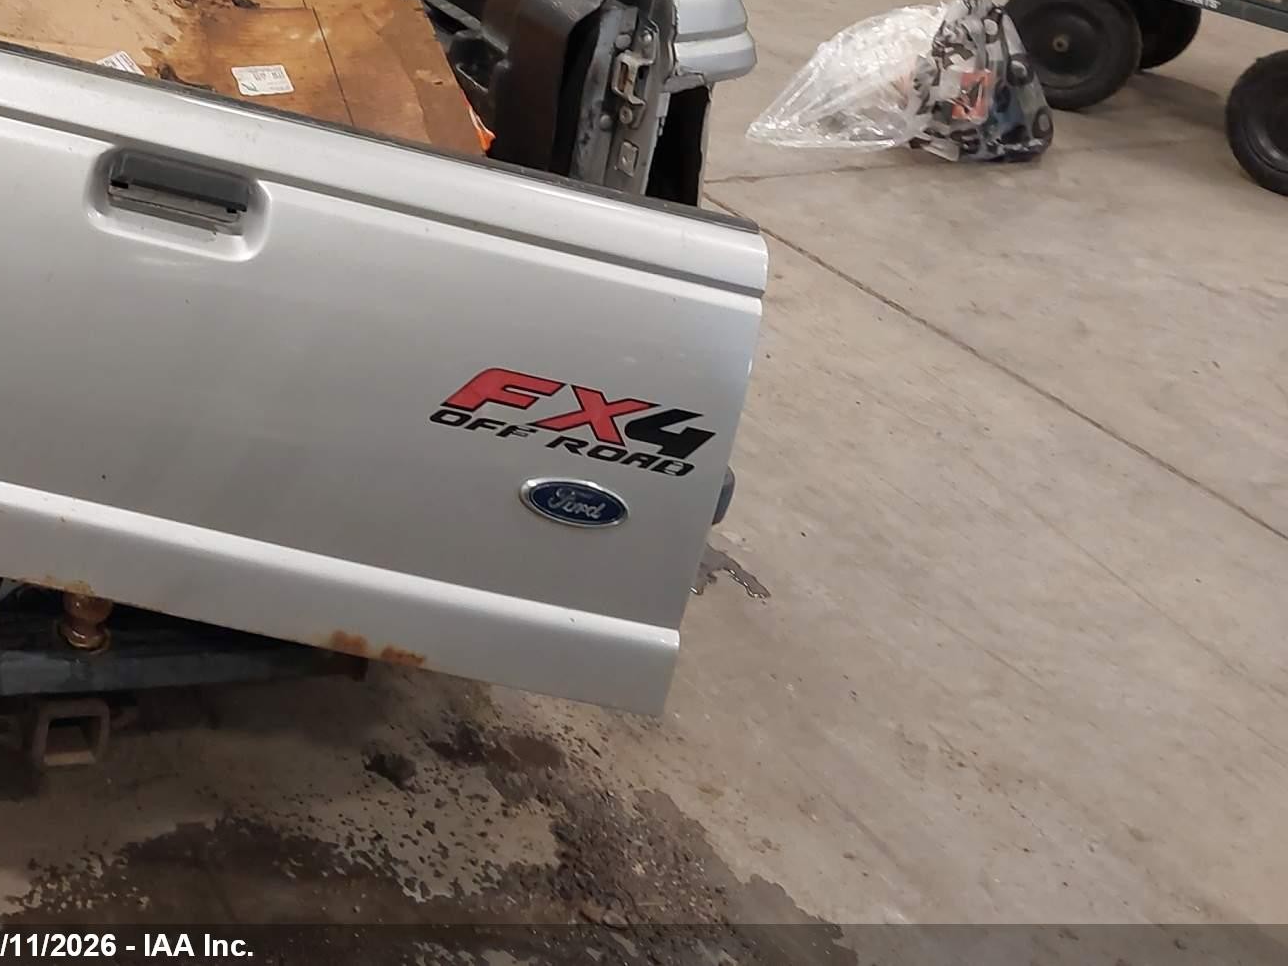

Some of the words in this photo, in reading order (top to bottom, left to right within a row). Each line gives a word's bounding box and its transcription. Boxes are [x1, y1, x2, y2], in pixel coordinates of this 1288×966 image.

[429, 409, 538, 438] OFF
[545, 436, 695, 477] ROAD
[440, 367, 716, 459] FX4
[547, 488, 607, 519] Ford
